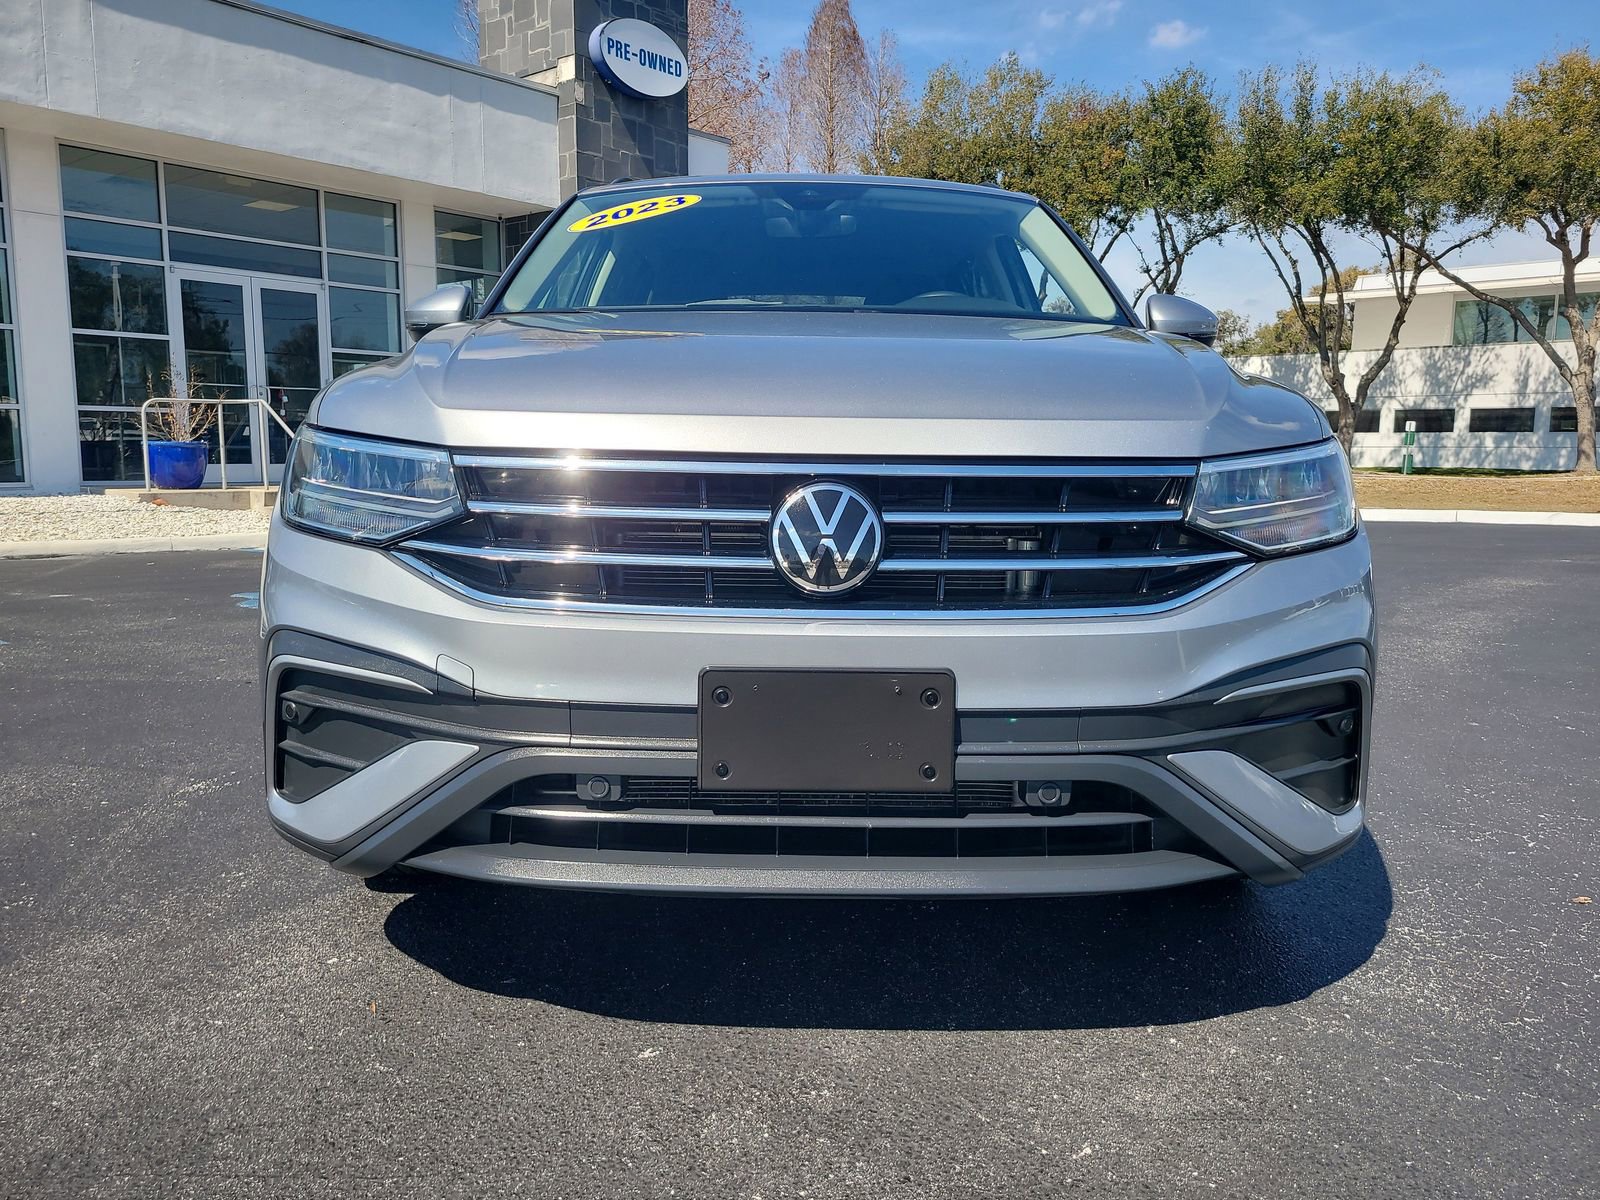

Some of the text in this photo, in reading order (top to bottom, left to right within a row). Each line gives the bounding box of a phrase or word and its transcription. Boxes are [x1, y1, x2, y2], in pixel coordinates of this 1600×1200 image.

[607, 37, 682, 77] PRE-OWNED
[585, 197, 686, 228] 2023
[776, 485, 878, 581] VW
